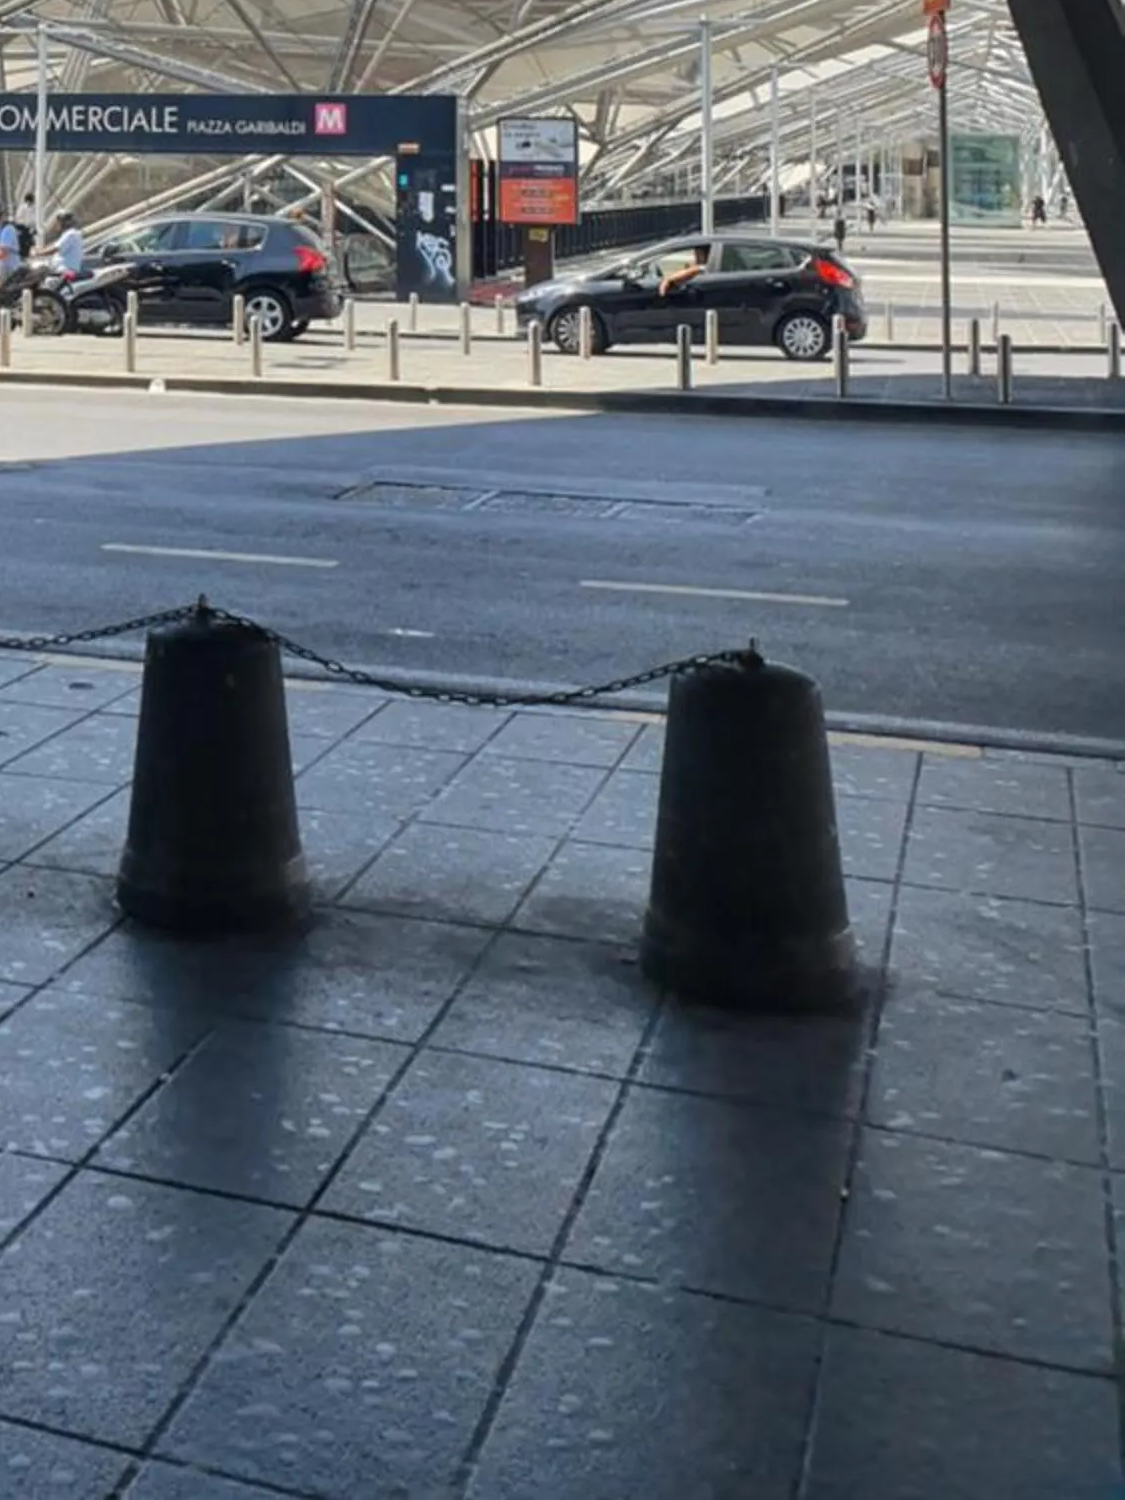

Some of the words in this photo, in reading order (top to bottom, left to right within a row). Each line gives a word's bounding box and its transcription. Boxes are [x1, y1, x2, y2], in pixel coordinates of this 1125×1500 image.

[187, 119, 232, 134] PIAZZA
[236, 119, 306, 135] GARIBALDI
[317, 106, 344, 131] M
